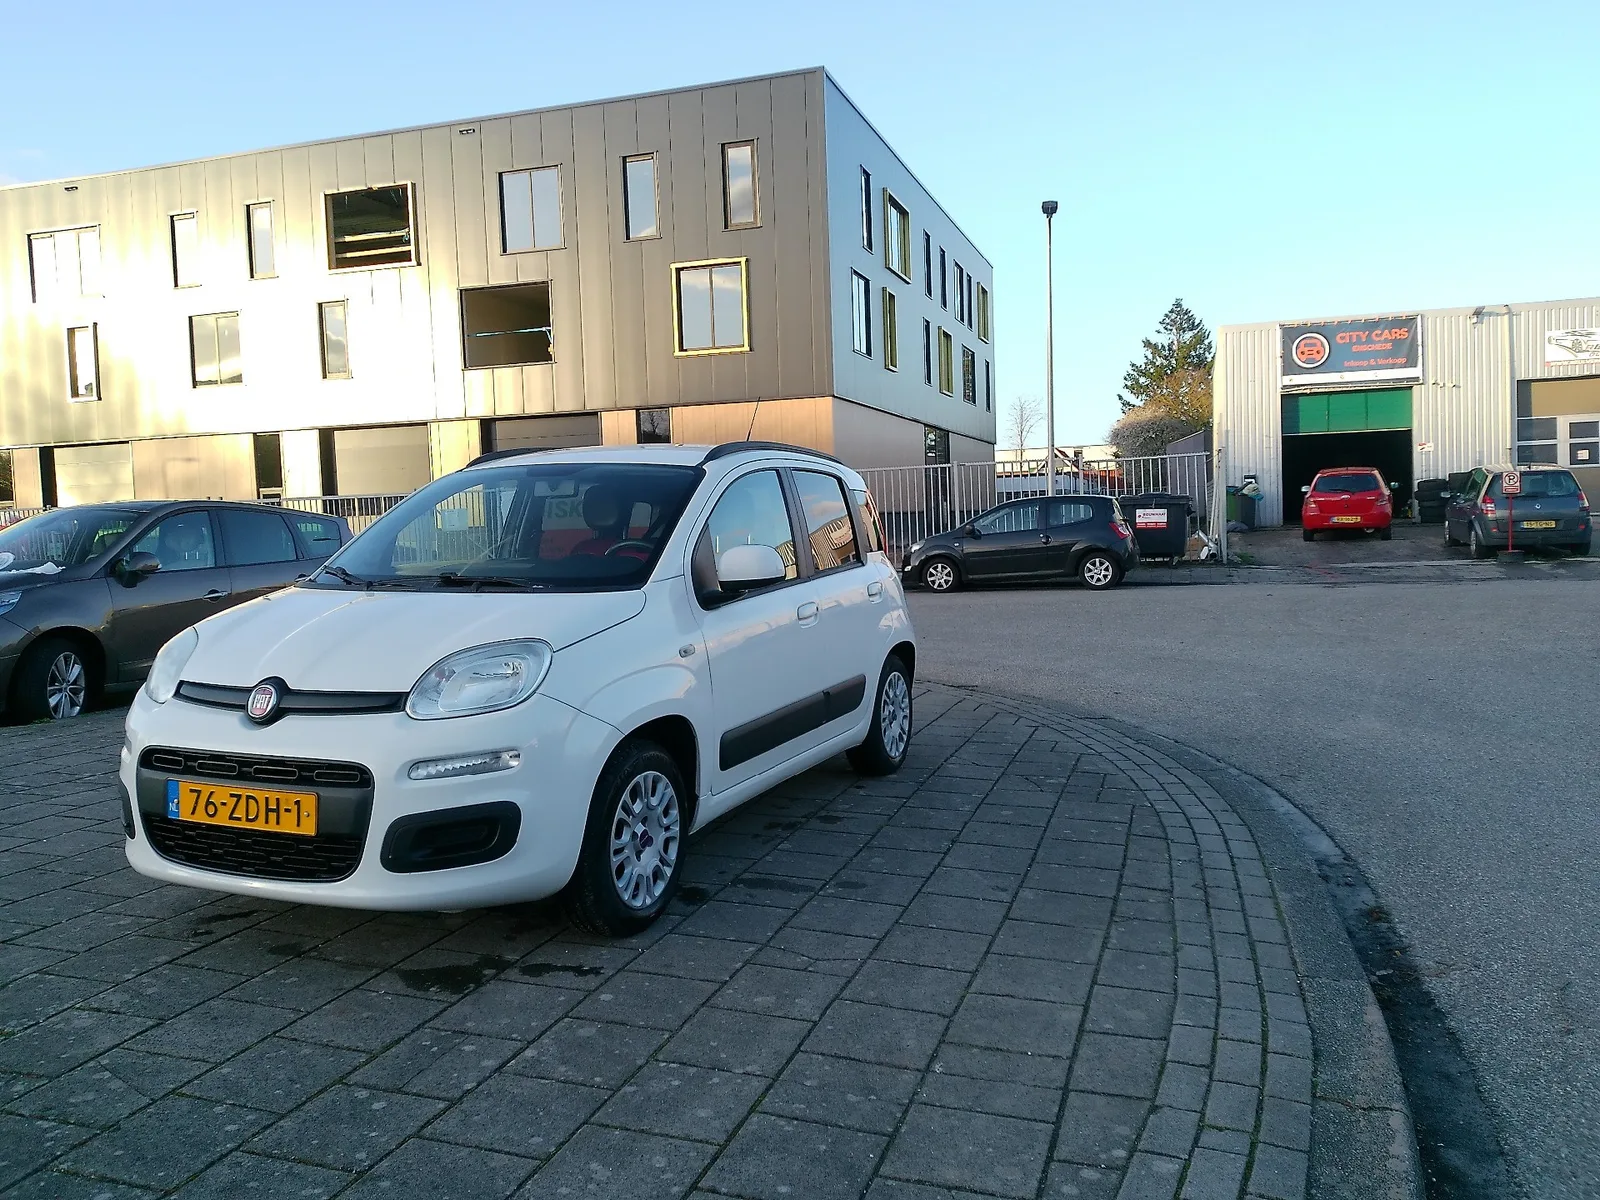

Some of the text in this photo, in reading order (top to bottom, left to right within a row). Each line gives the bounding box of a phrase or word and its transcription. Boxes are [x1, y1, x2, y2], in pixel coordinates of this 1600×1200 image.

[1335, 327, 1409, 344] CITY CARS
[1377, 357, 1407, 365] Verkoop
[169, 804, 178, 812] NL
[189, 786, 301, 828] 76-ZDH-1
